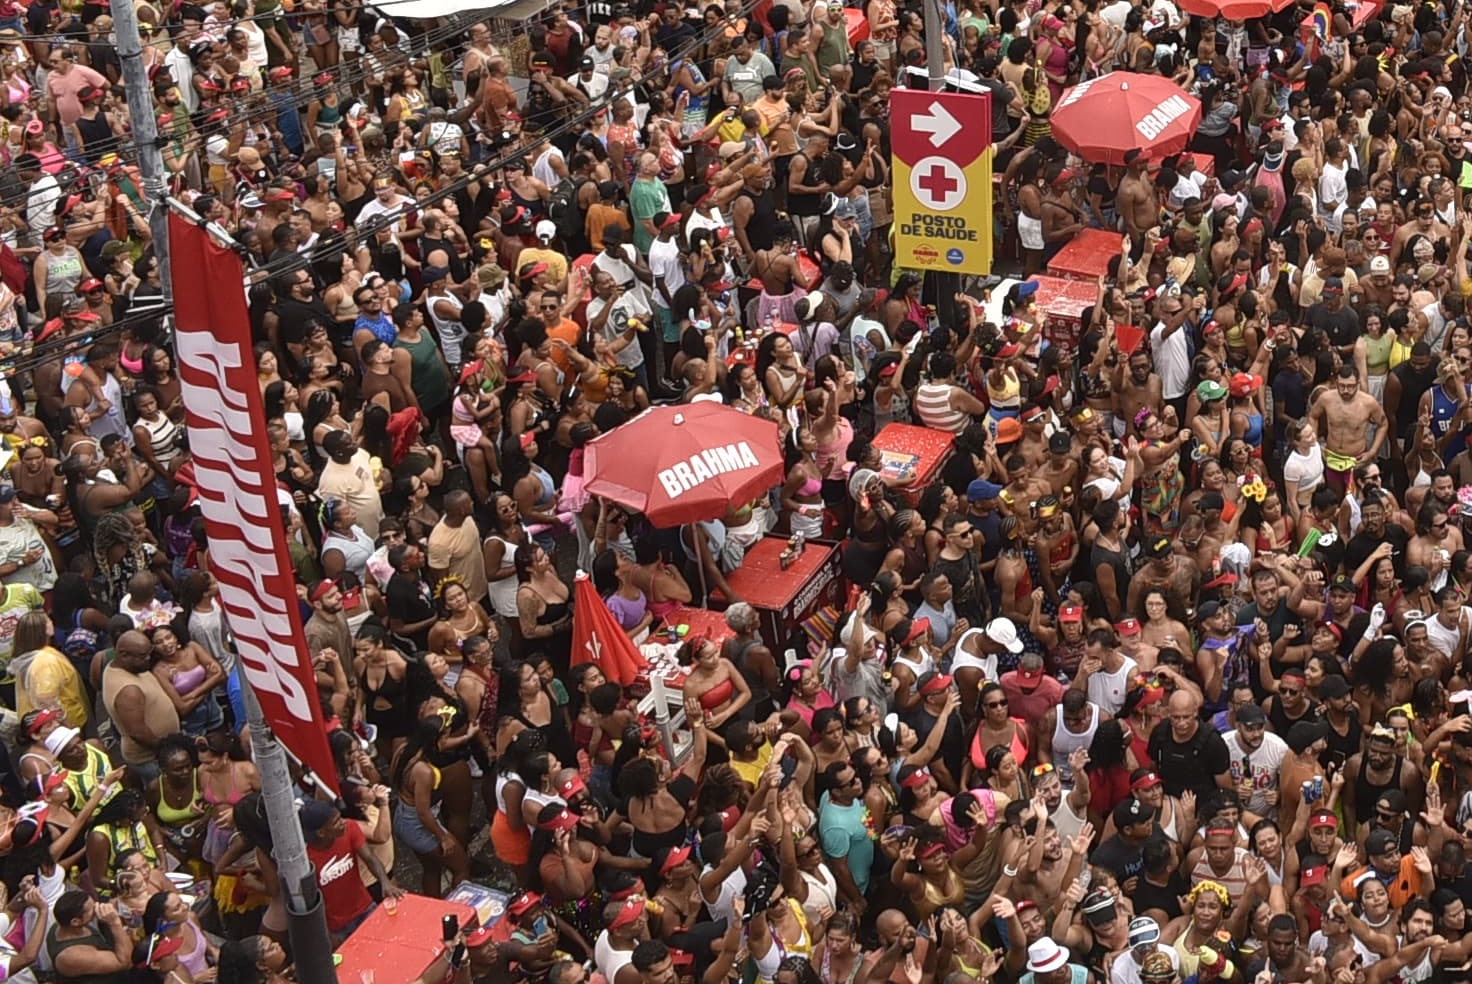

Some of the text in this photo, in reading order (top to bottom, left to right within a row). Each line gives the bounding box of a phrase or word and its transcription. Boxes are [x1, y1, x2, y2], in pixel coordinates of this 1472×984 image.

[1136, 94, 1192, 141] BRAHMA
[901, 224, 922, 237] DE
[912, 213, 966, 229] POSTO
[658, 441, 760, 500] BRAHMA
[175, 330, 313, 723] BRAHMA
